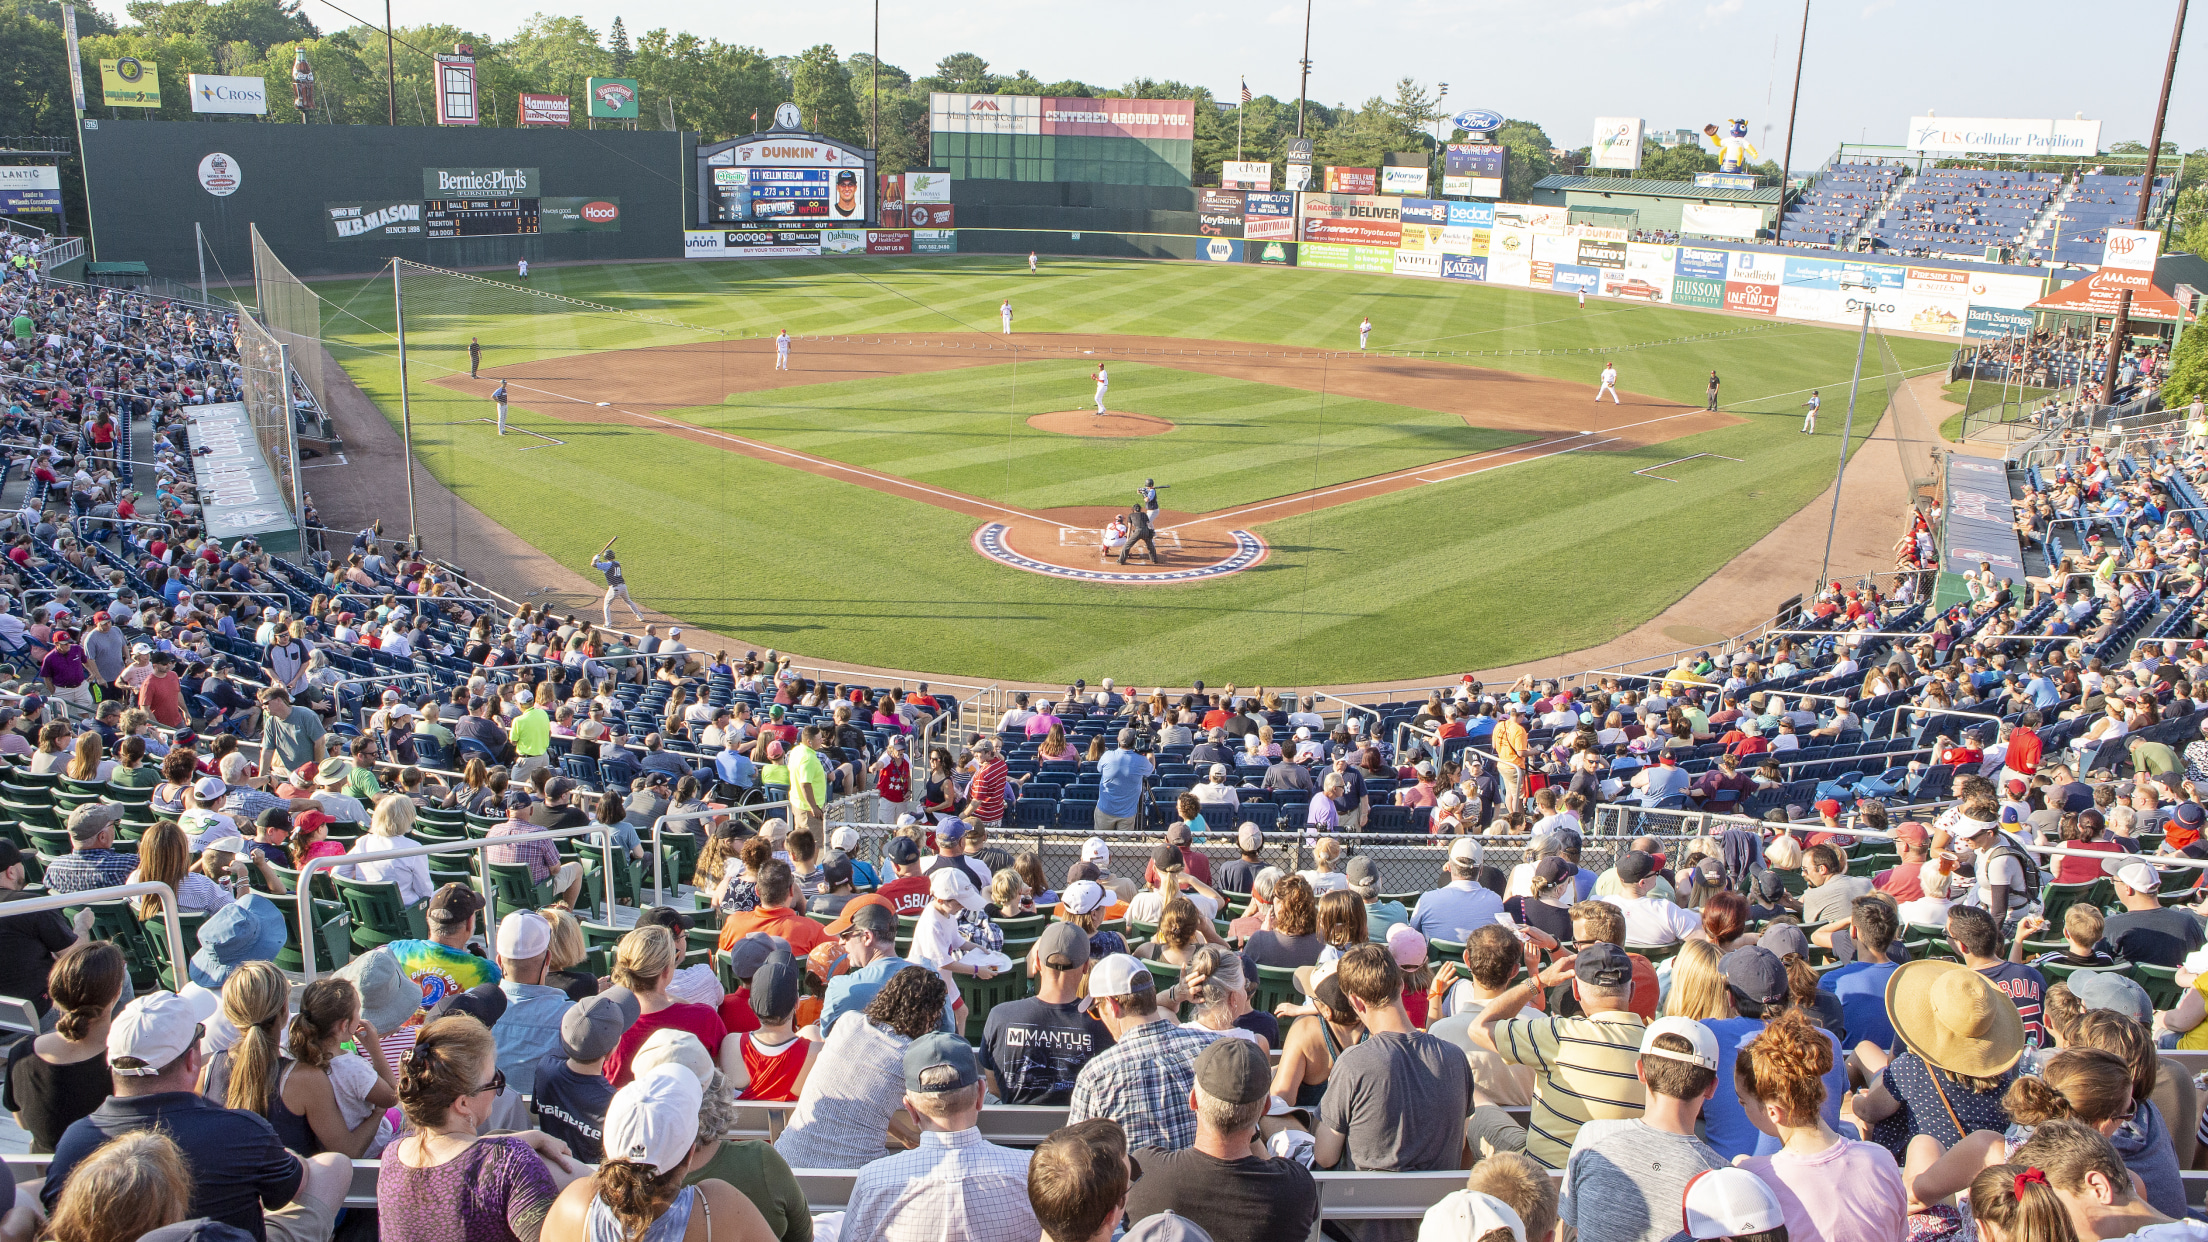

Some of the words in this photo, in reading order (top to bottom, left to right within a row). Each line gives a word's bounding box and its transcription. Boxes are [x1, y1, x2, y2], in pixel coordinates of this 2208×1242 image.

[460, 44, 473, 54] PG
[216, 86, 262, 101] CROSS
[598, 86, 631, 98] Hannaford
[524, 97, 568, 110] Hammond
[546, 112, 568, 121] Company
[947, 112, 969, 120] Maine
[971, 113, 998, 121] Medical
[1000, 114, 1023, 122] Center
[1045, 110, 1108, 124] CENTERED
[1112, 112, 1158, 124] AROUND
[1162, 114, 1189, 126] YOU.
[1462, 114, 1491, 127] Ford
[1598, 137, 1631, 147] TARGET
[1942, 132, 1962, 144] U.S.
[1966, 132, 2022, 146] Cellular
[2027, 134, 2084, 148] Pavilion
[762, 147, 818, 158] DUNKIN'
[1289, 152, 1311, 160] MAST
[1240, 163, 1266, 173] cPort
[438, 169, 527, 194] Bernie&Phyl's
[762, 172, 781, 180] KELLIN
[1394, 172, 1424, 180] Norway
[1248, 194, 1290, 202] SUPERCUTS
[432, 201, 441, 210] 11
[463, 201, 468, 209] 0
[756, 201, 795, 214] FIREWORKS
[331, 209, 347, 217] WHO
[347, 208, 361, 216] BUT
[586, 207, 615, 218] Hood
[1350, 206, 1399, 219] DELIVER
[1402, 207, 1432, 216] MAINE'S
[1450, 205, 1493, 220] bedard
[334, 204, 420, 238] W.B.MASON
[1201, 215, 1242, 225] KeyBank
[1248, 221, 1290, 233] HANDYMAN
[1306, 220, 1359, 234] Emerson
[1360, 228, 1400, 237] Toyota.com
[827, 232, 859, 242] Oakhurst
[1586, 229, 1625, 239] DUNKIN'
[685, 236, 717, 247] unum
[2111, 237, 2133, 254] AAA
[1211, 244, 1228, 254] NAPA
[1579, 248, 1625, 260] AMATO'S
[1683, 248, 1723, 262] Bangor
[1363, 255, 1378, 263] keep
[1398, 256, 1437, 265] WIPFLI
[1680, 259, 1706, 267] Savings
[1443, 261, 1484, 280] KAYEM
[1734, 268, 1776, 282] headlight
[1867, 266, 1904, 275] Propane?
[1912, 270, 1947, 281] FIRESIDE
[1950, 273, 1964, 282] INN
[1556, 272, 1596, 286] MEMIC
[2102, 272, 2148, 286] AAA.com
[1676, 280, 1721, 297] HUSSON
[1925, 284, 1955, 292] SUITES
[1675, 294, 1719, 304] UNIVERSITY
[1727, 292, 1777, 305] INFINITY
[1845, 298, 1896, 313] OTELCO
[1969, 310, 1992, 321] Bath
[1994, 312, 2033, 327] Savings
[197, 418, 244, 458] Eastern
[202, 457, 260, 506] League
[411, 966, 446, 980] BULLIES
[444, 974, 458, 991] BBQ
[1025, 1029, 1092, 1046] MANTUS
[1025, 1041, 1092, 1052] ANCHORS
